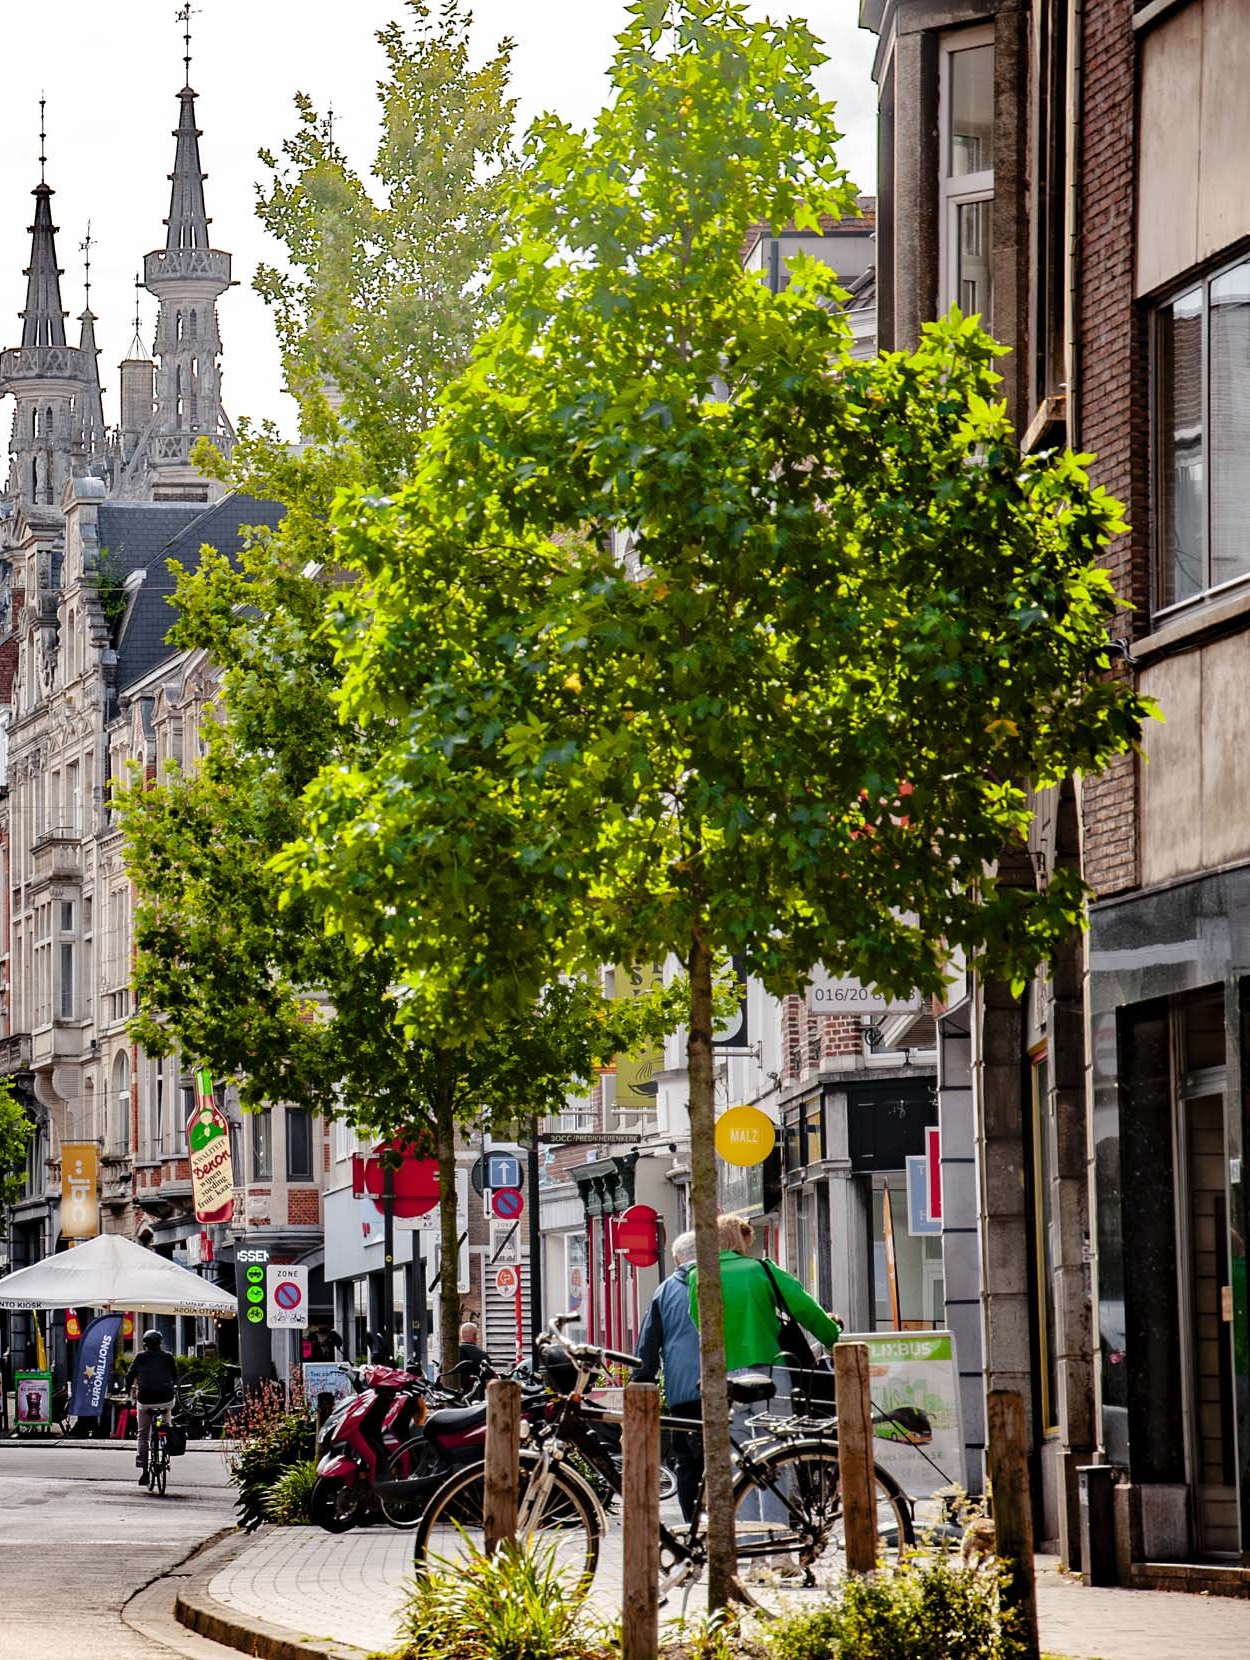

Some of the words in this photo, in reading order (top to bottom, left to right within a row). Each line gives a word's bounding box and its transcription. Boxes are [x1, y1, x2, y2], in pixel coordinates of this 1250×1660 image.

[815, 988, 868, 1001] 016/20
[729, 1128, 759, 1145] MALZ
[192, 1139, 226, 1166] KWALITEIT
[199, 1170, 222, 1187] wijnen
[201, 1175, 228, 1197] voeding
[197, 1194, 214, 1209] fruit
[215, 1182, 232, 1197] kaas
[16, 1301, 42, 1309] KIOSK
[91, 1334, 112, 1407] EUROMILLIONS
